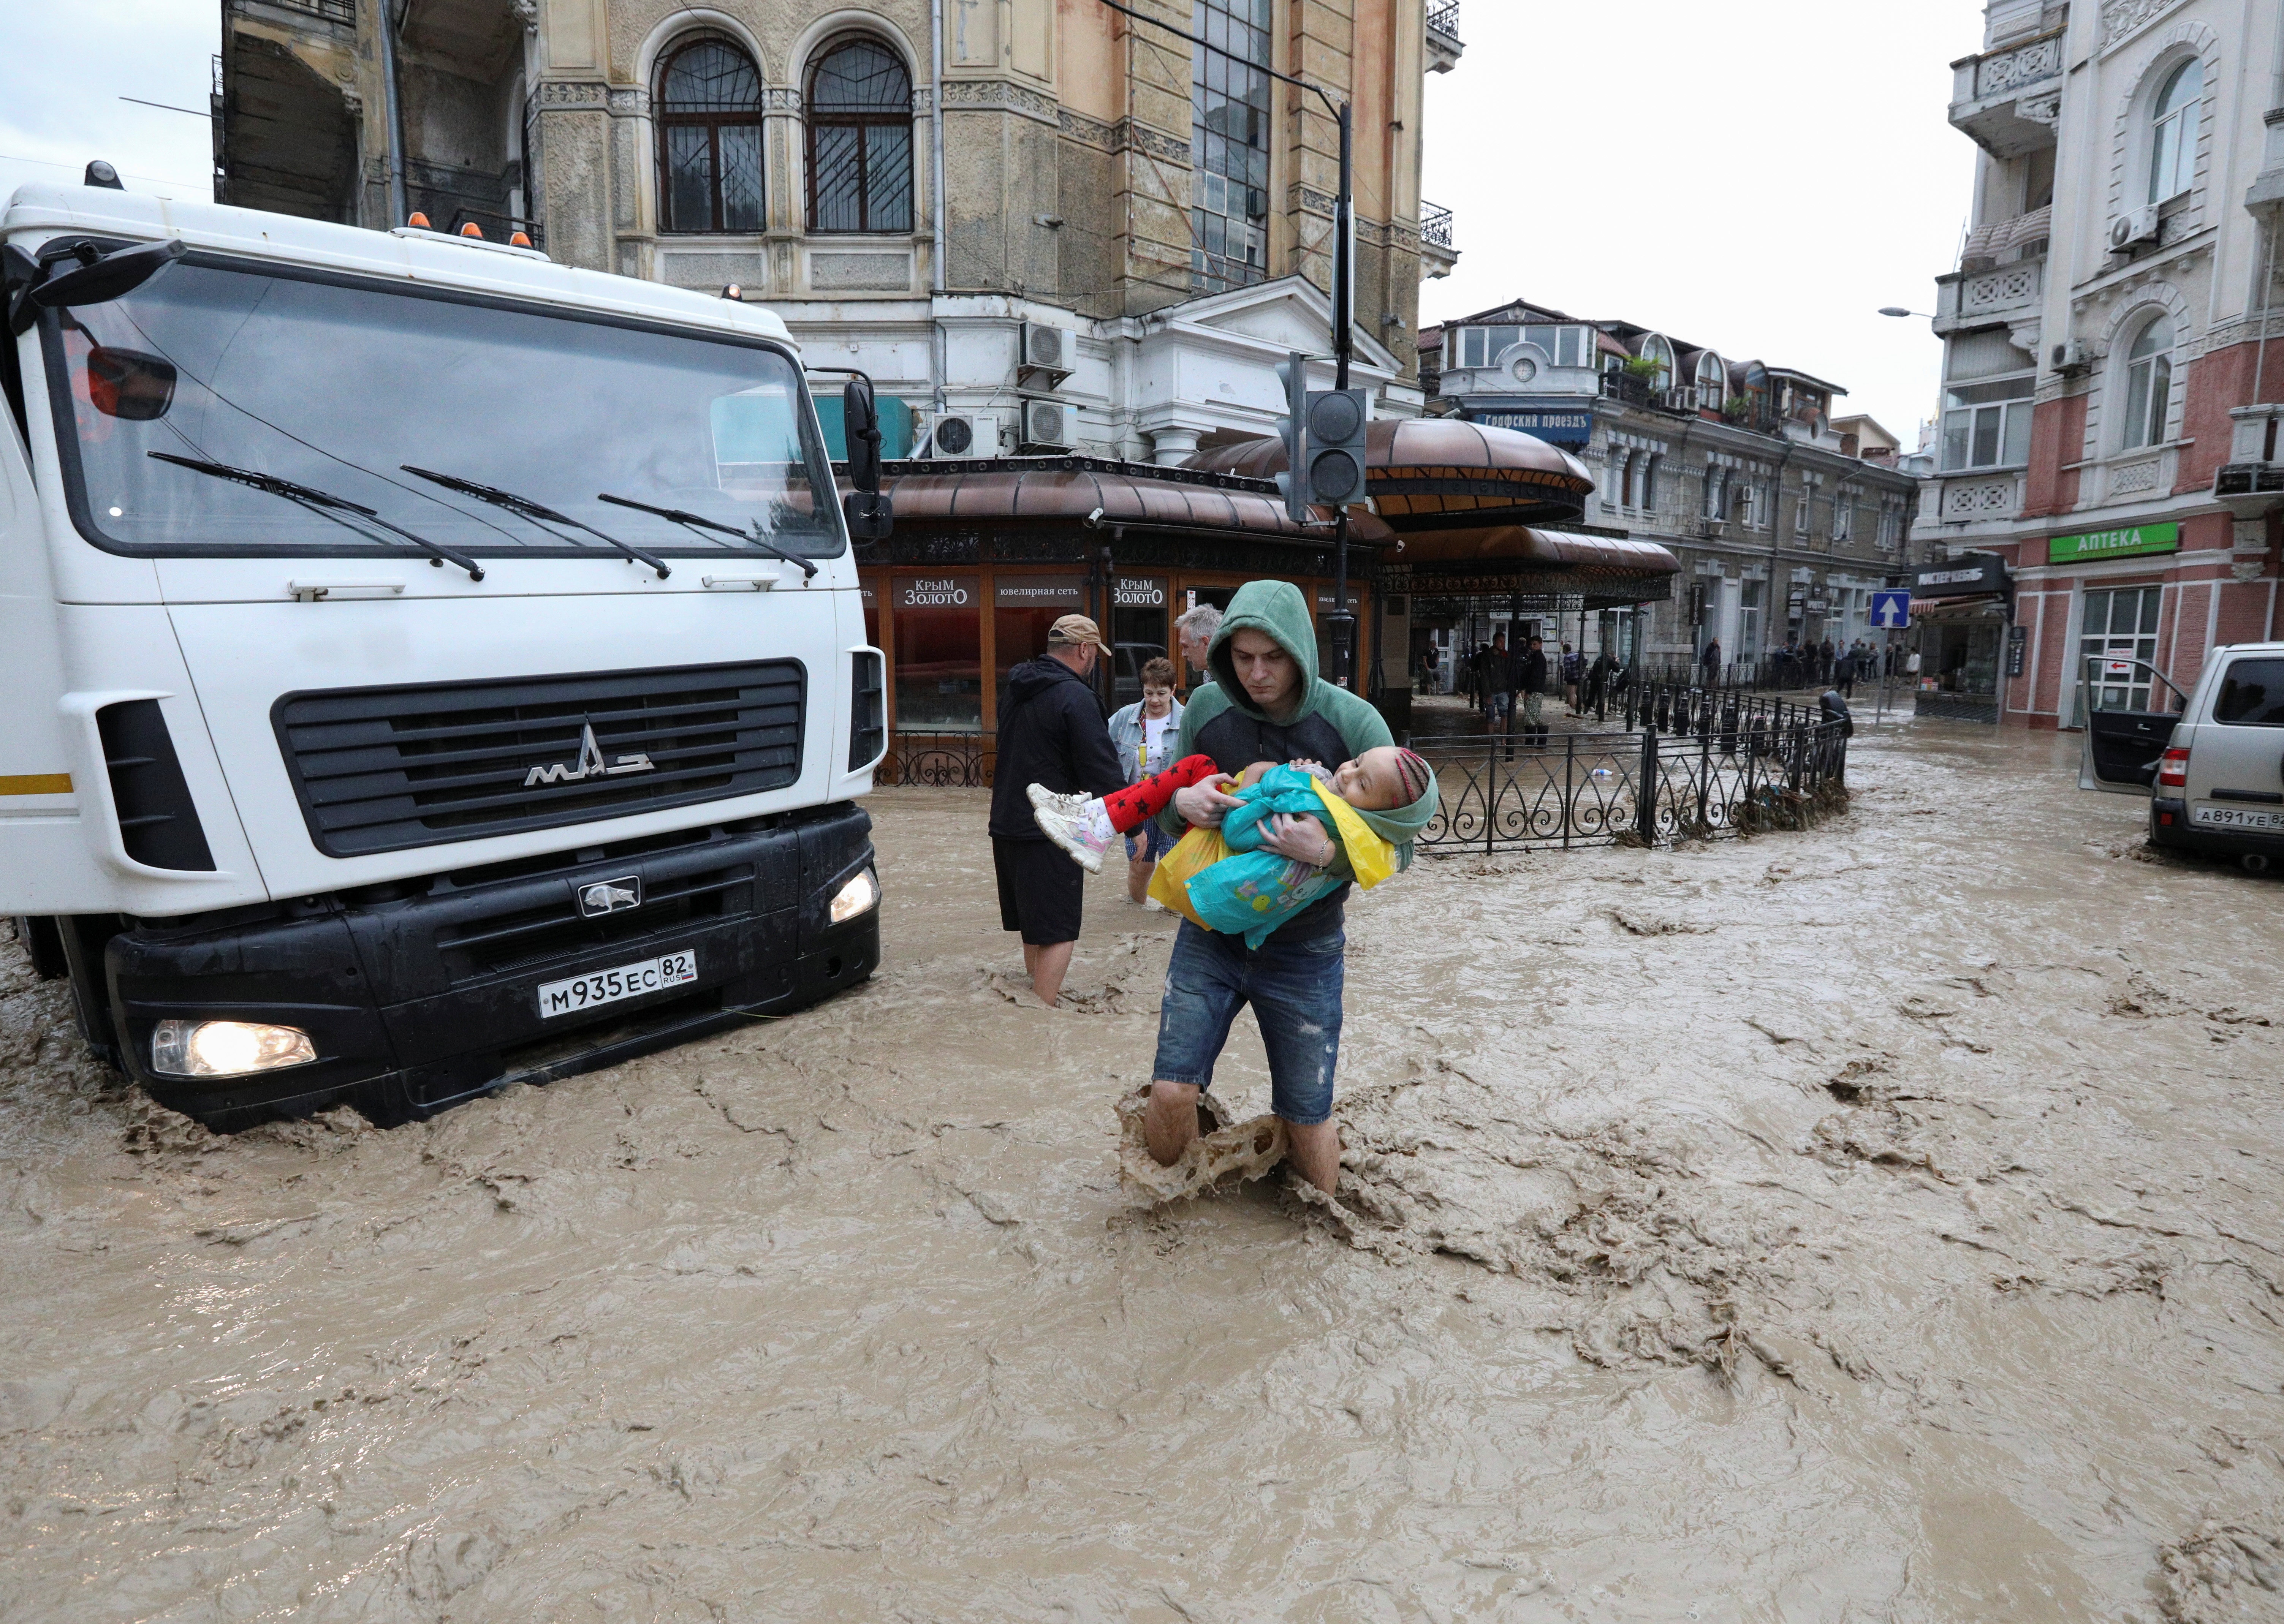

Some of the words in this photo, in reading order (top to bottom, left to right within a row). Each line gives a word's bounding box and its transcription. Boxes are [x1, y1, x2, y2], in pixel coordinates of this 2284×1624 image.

[1485, 414, 1537, 428] Графский
[1542, 415, 1587, 428] проездъ
[2078, 530, 2142, 551] АПТЕКА
[1000, 588, 1054, 597] ювелирная
[551, 969, 657, 1011] М935ЕС
[663, 956, 686, 976] 82
[663, 975, 681, 984] RUS
